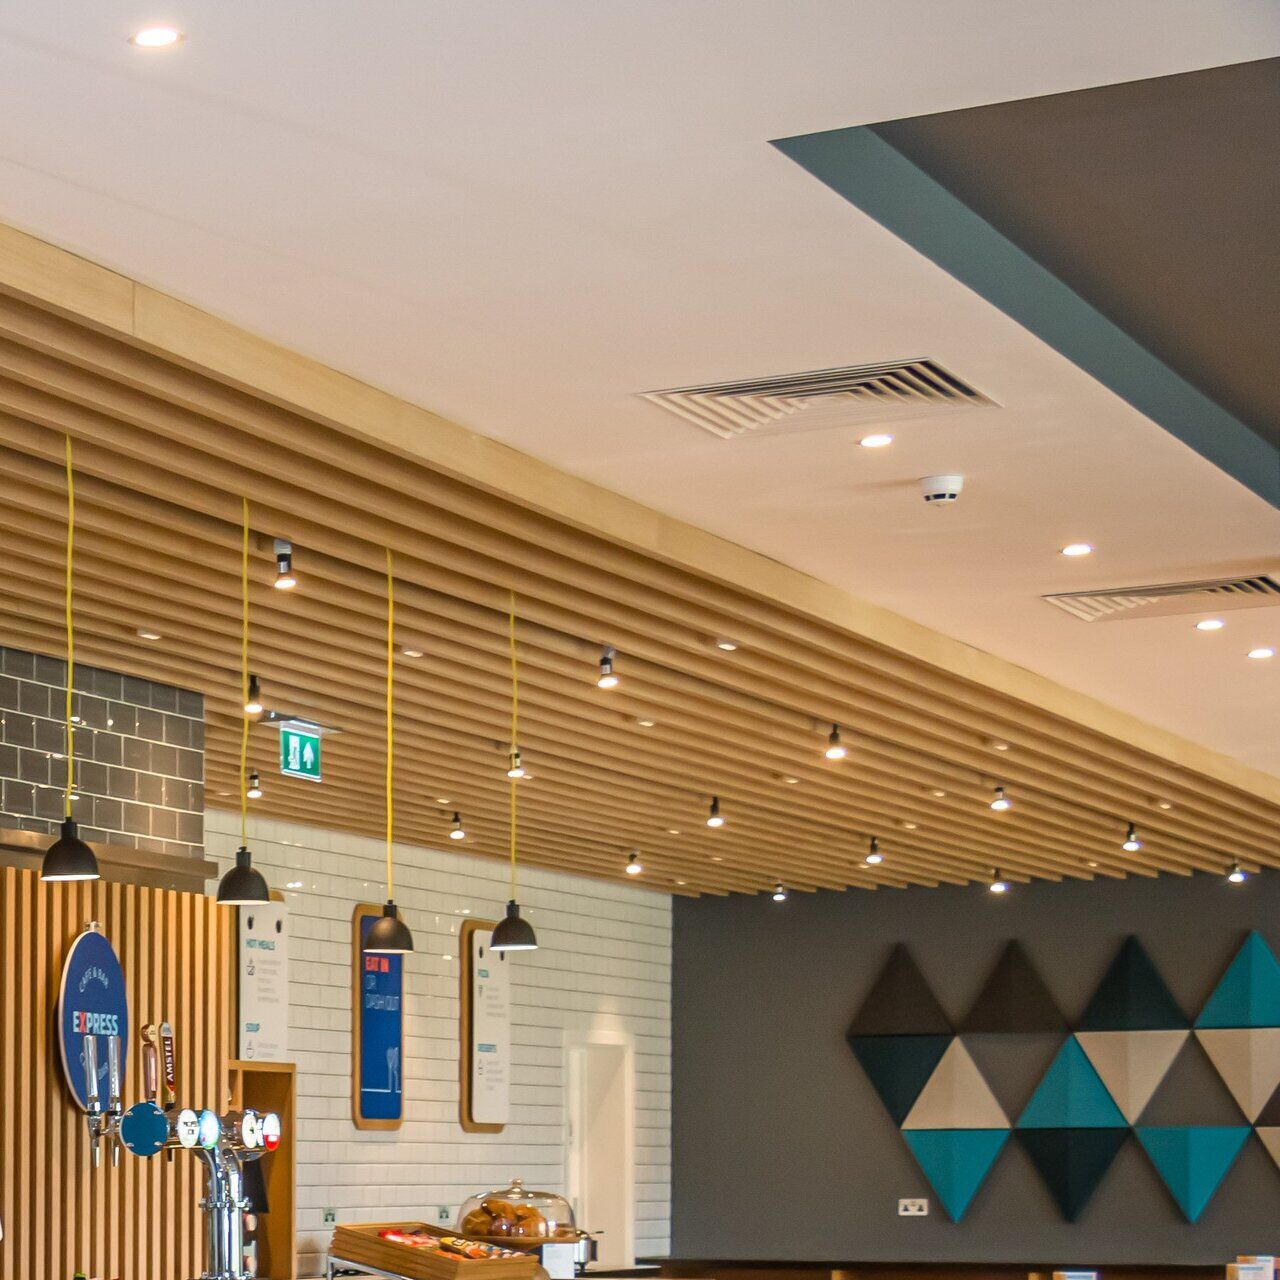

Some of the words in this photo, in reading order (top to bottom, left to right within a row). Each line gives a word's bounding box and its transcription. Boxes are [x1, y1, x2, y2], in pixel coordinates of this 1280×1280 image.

[365, 956, 379, 971] EAT
[380, 958, 390, 973] IN
[72, 1010, 119, 1036] EXPRESS
[164, 1039, 174, 1081] AMSTEL
